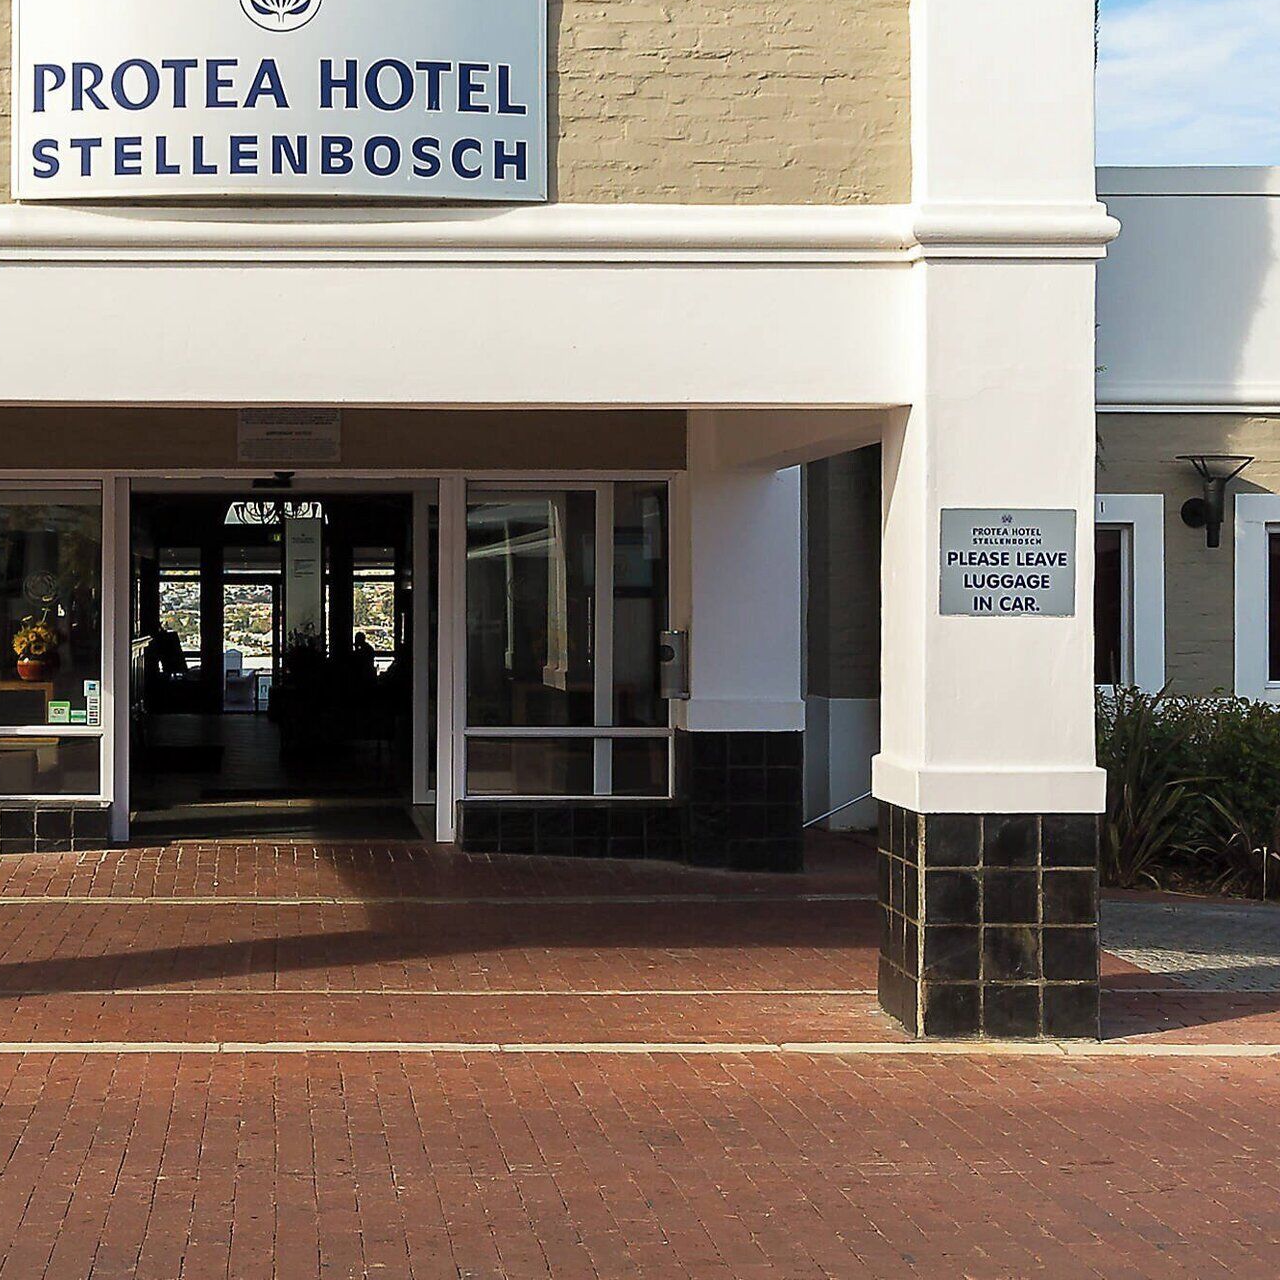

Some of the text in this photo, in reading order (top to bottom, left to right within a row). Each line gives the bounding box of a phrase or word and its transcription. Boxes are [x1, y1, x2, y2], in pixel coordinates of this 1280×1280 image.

[32, 58, 527, 115] PROTEA HOTEL
[32, 135, 527, 181] STELLENBOSCH
[972, 527, 1042, 536] PROTEA HOTEL
[972, 537, 1042, 545] STELLENBOSCH
[947, 551, 1067, 567] PLEASE LEAVE
[964, 573, 1050, 590] LUGGAGE
[973, 596, 1040, 612] IN CAR.
